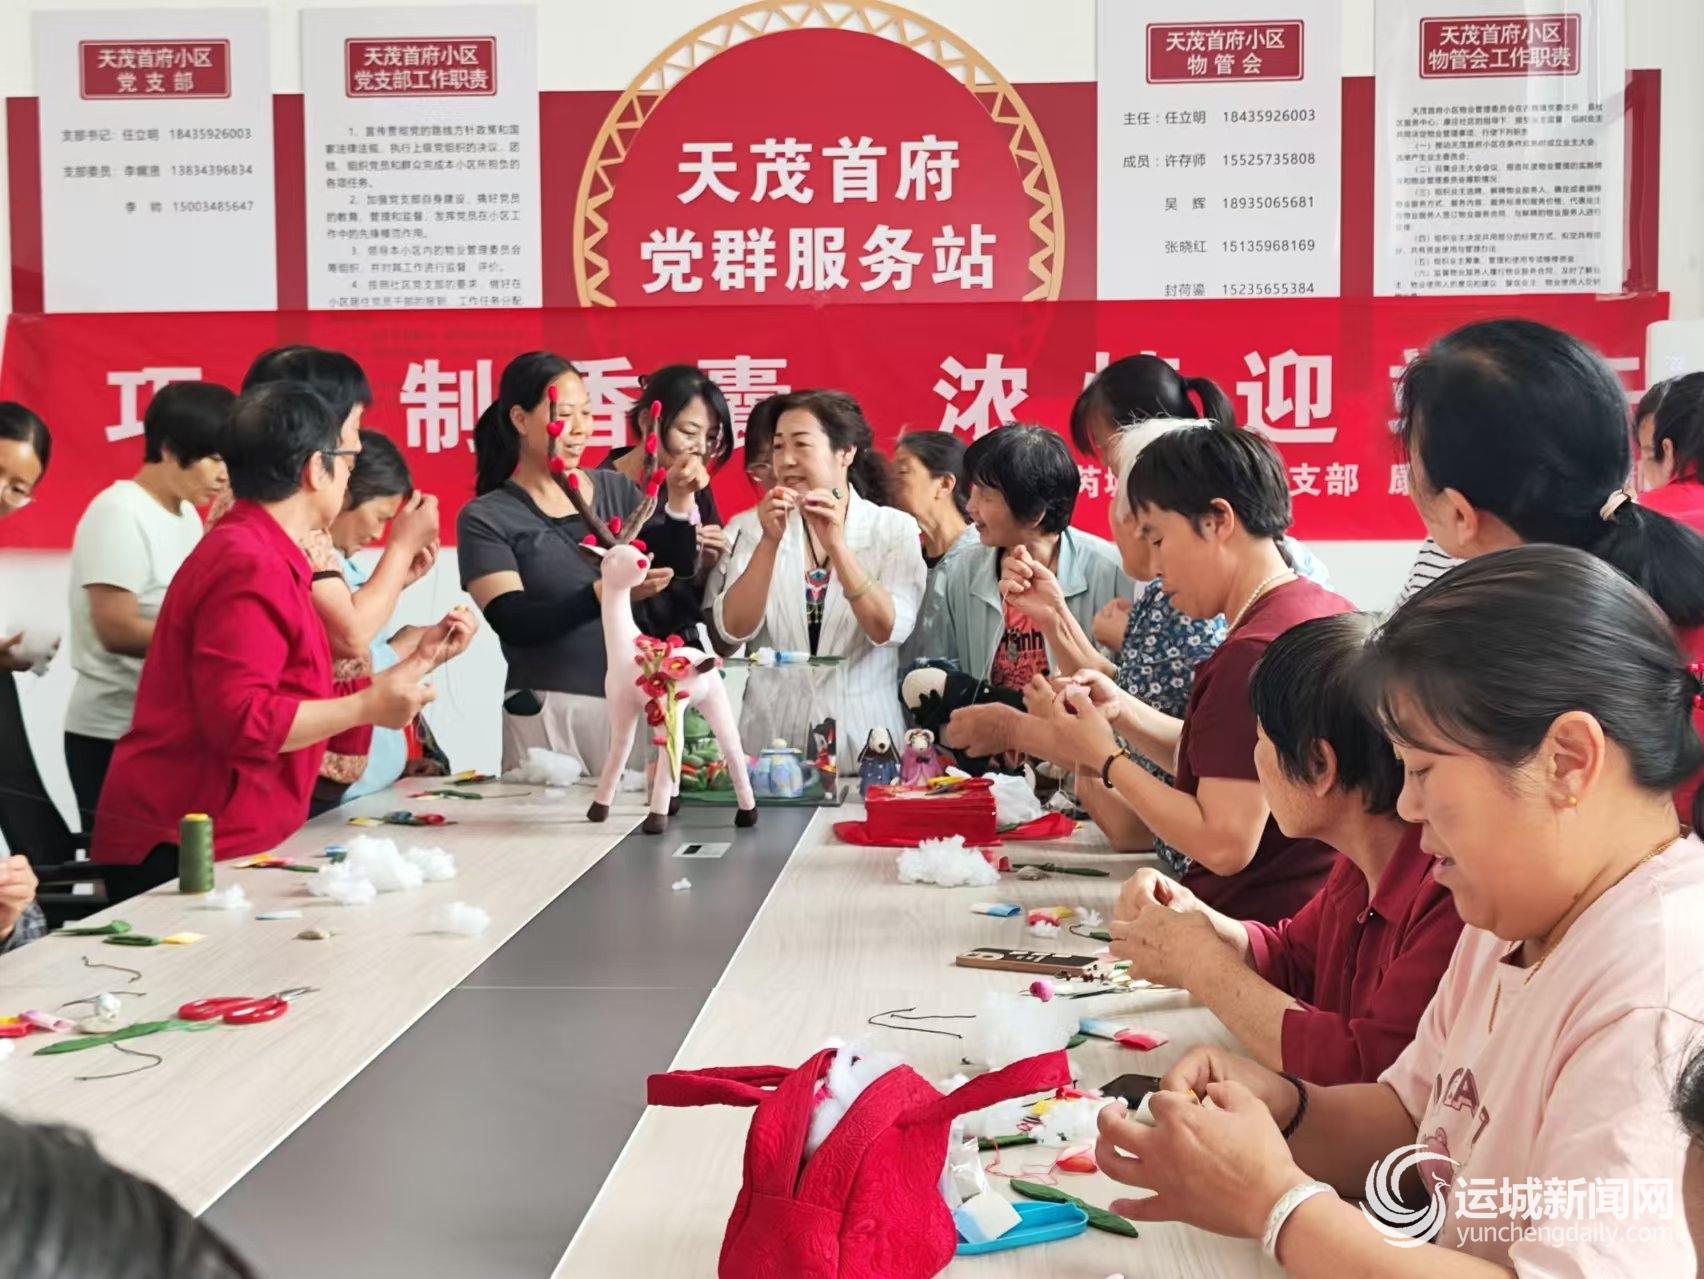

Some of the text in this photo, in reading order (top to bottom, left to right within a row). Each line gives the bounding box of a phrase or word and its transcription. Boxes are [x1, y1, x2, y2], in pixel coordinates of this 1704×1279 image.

[1165, 28, 1285, 52] 天茂首府小区
[1440, 22, 1562, 46] 天茂首府小区
[98, 47, 213, 69] 天茂首府小区
[363, 44, 479, 66] 天茂首府小区
[1428, 45, 1572, 70] 物管会工作职责
[354, 69, 489, 92] 党支部工作职责
[1223, 109, 1315, 123] 18435926003
[169, 128, 252, 140] 18435926003
[1223, 153, 1315, 167] 15525735808
[171, 164, 253, 177] 13834396834
[677, 134, 960, 205] 天茂首府
[173, 201, 255, 213] 15003485647
[1222, 196, 1314, 210] 18935065681
[1164, 239, 1315, 254] 张晓红 15135968169
[640, 224, 997, 294] 党群服务站
[1222, 282, 1315, 296] 15235655384
